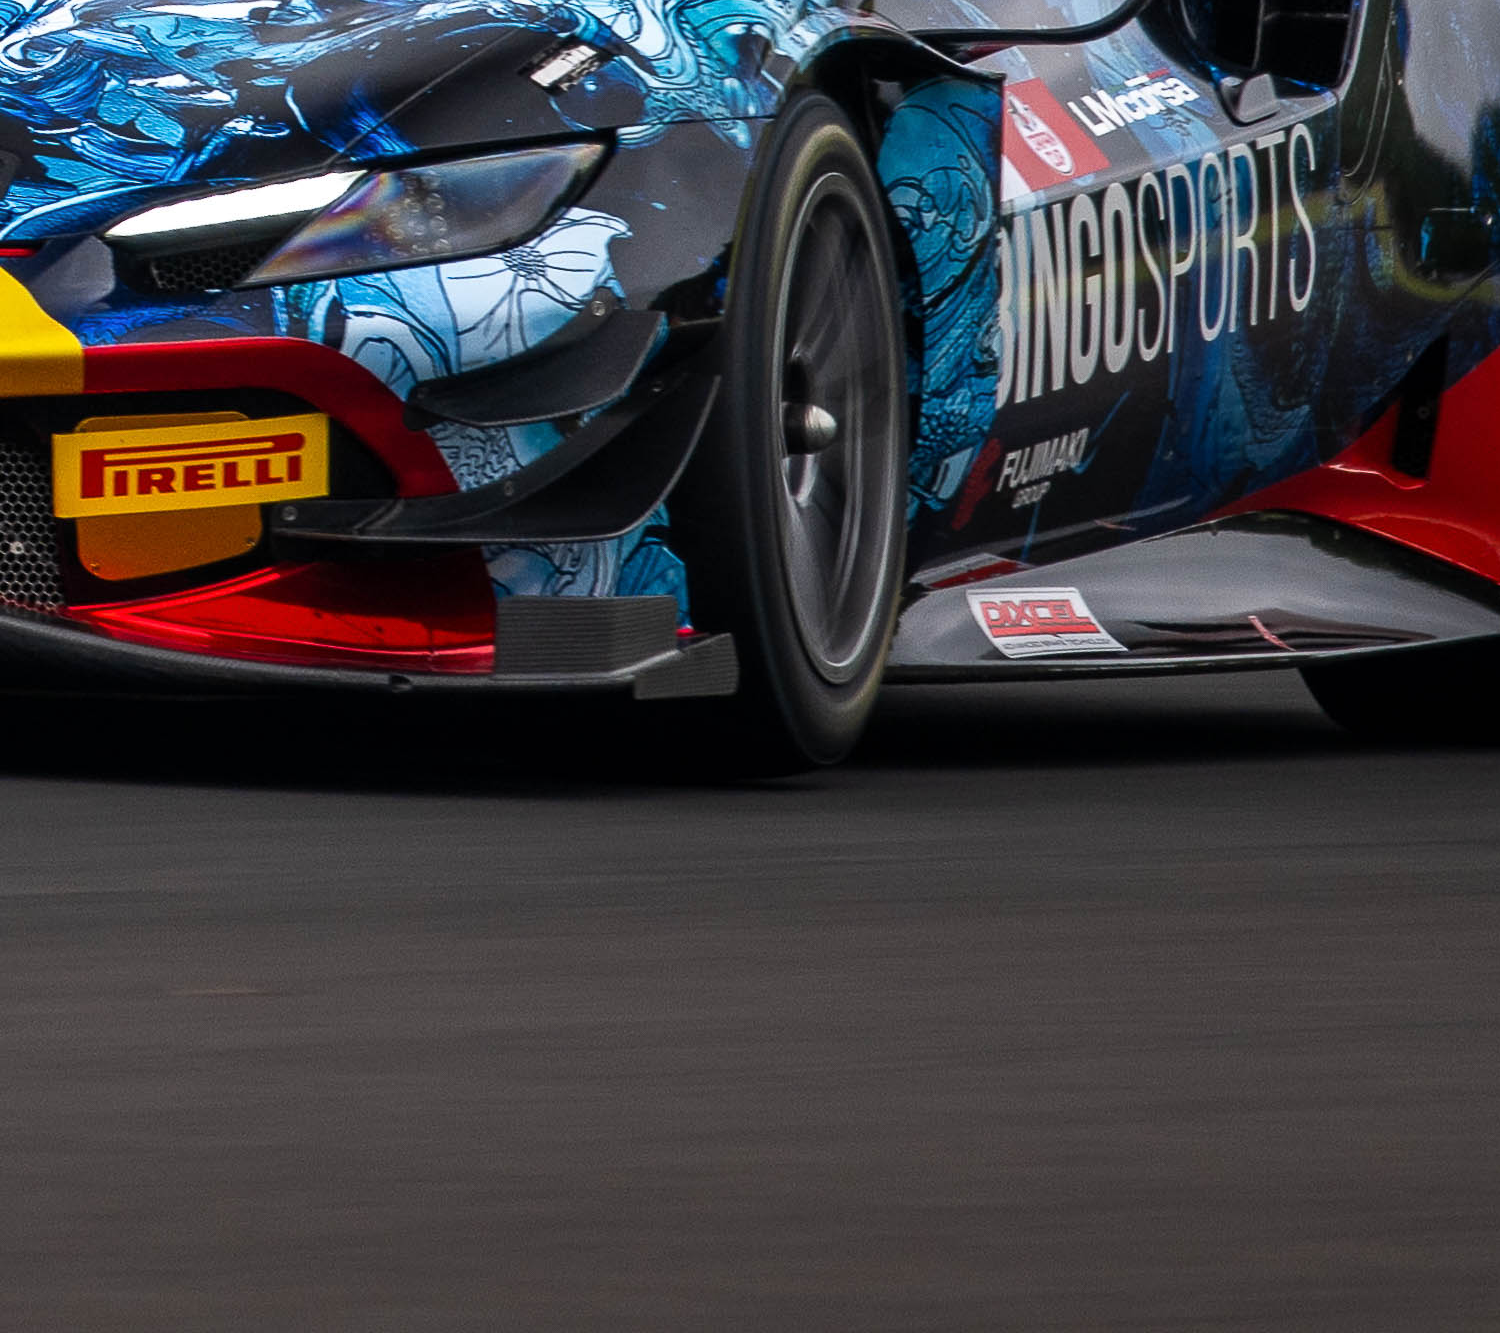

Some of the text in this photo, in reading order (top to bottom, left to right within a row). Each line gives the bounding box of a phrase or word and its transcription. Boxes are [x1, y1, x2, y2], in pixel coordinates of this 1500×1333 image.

[1067, 77, 1201, 137] LMcorsa
[80, 432, 306, 500] PIRELLI
[979, 598, 1094, 629] DIXCEL
